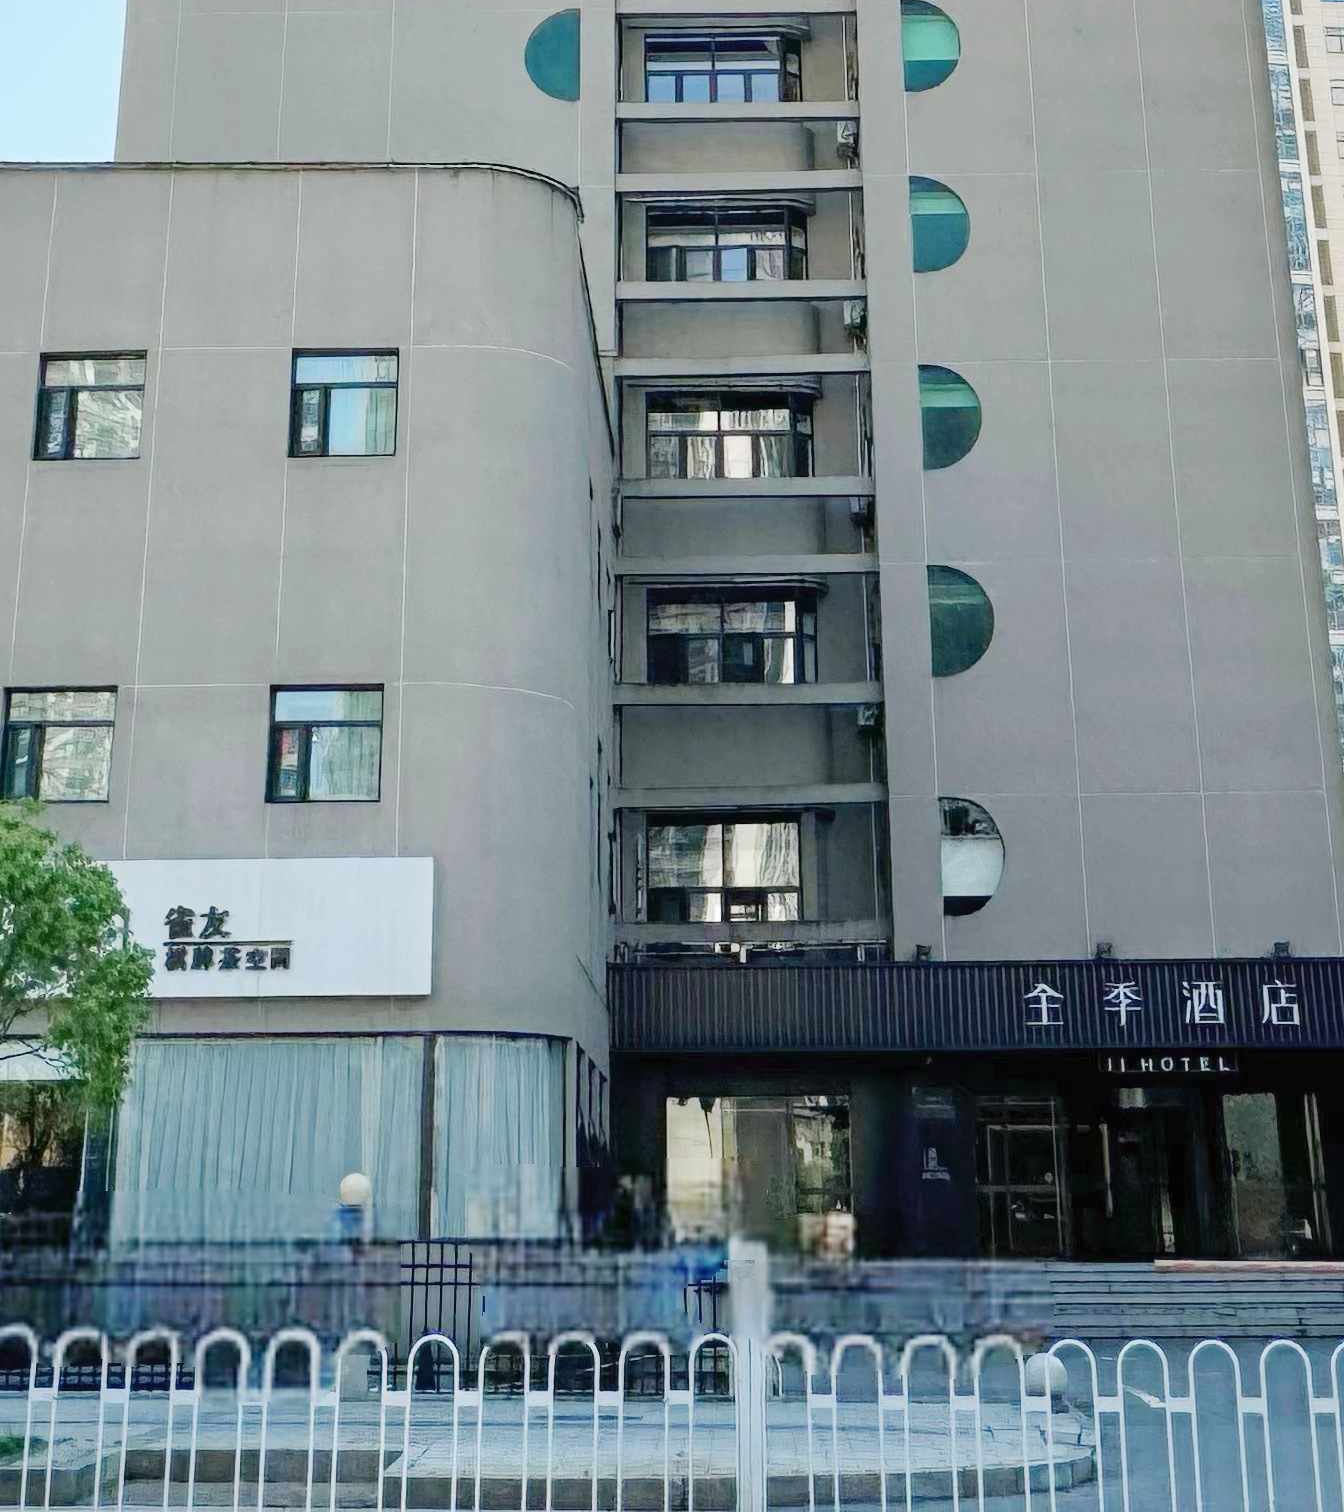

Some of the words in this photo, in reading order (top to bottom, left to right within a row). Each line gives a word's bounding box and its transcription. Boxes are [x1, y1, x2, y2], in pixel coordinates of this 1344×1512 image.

[1023, 978, 1301, 1028] 全季酒店
[1140, 1057, 1231, 1072] HOTEL
